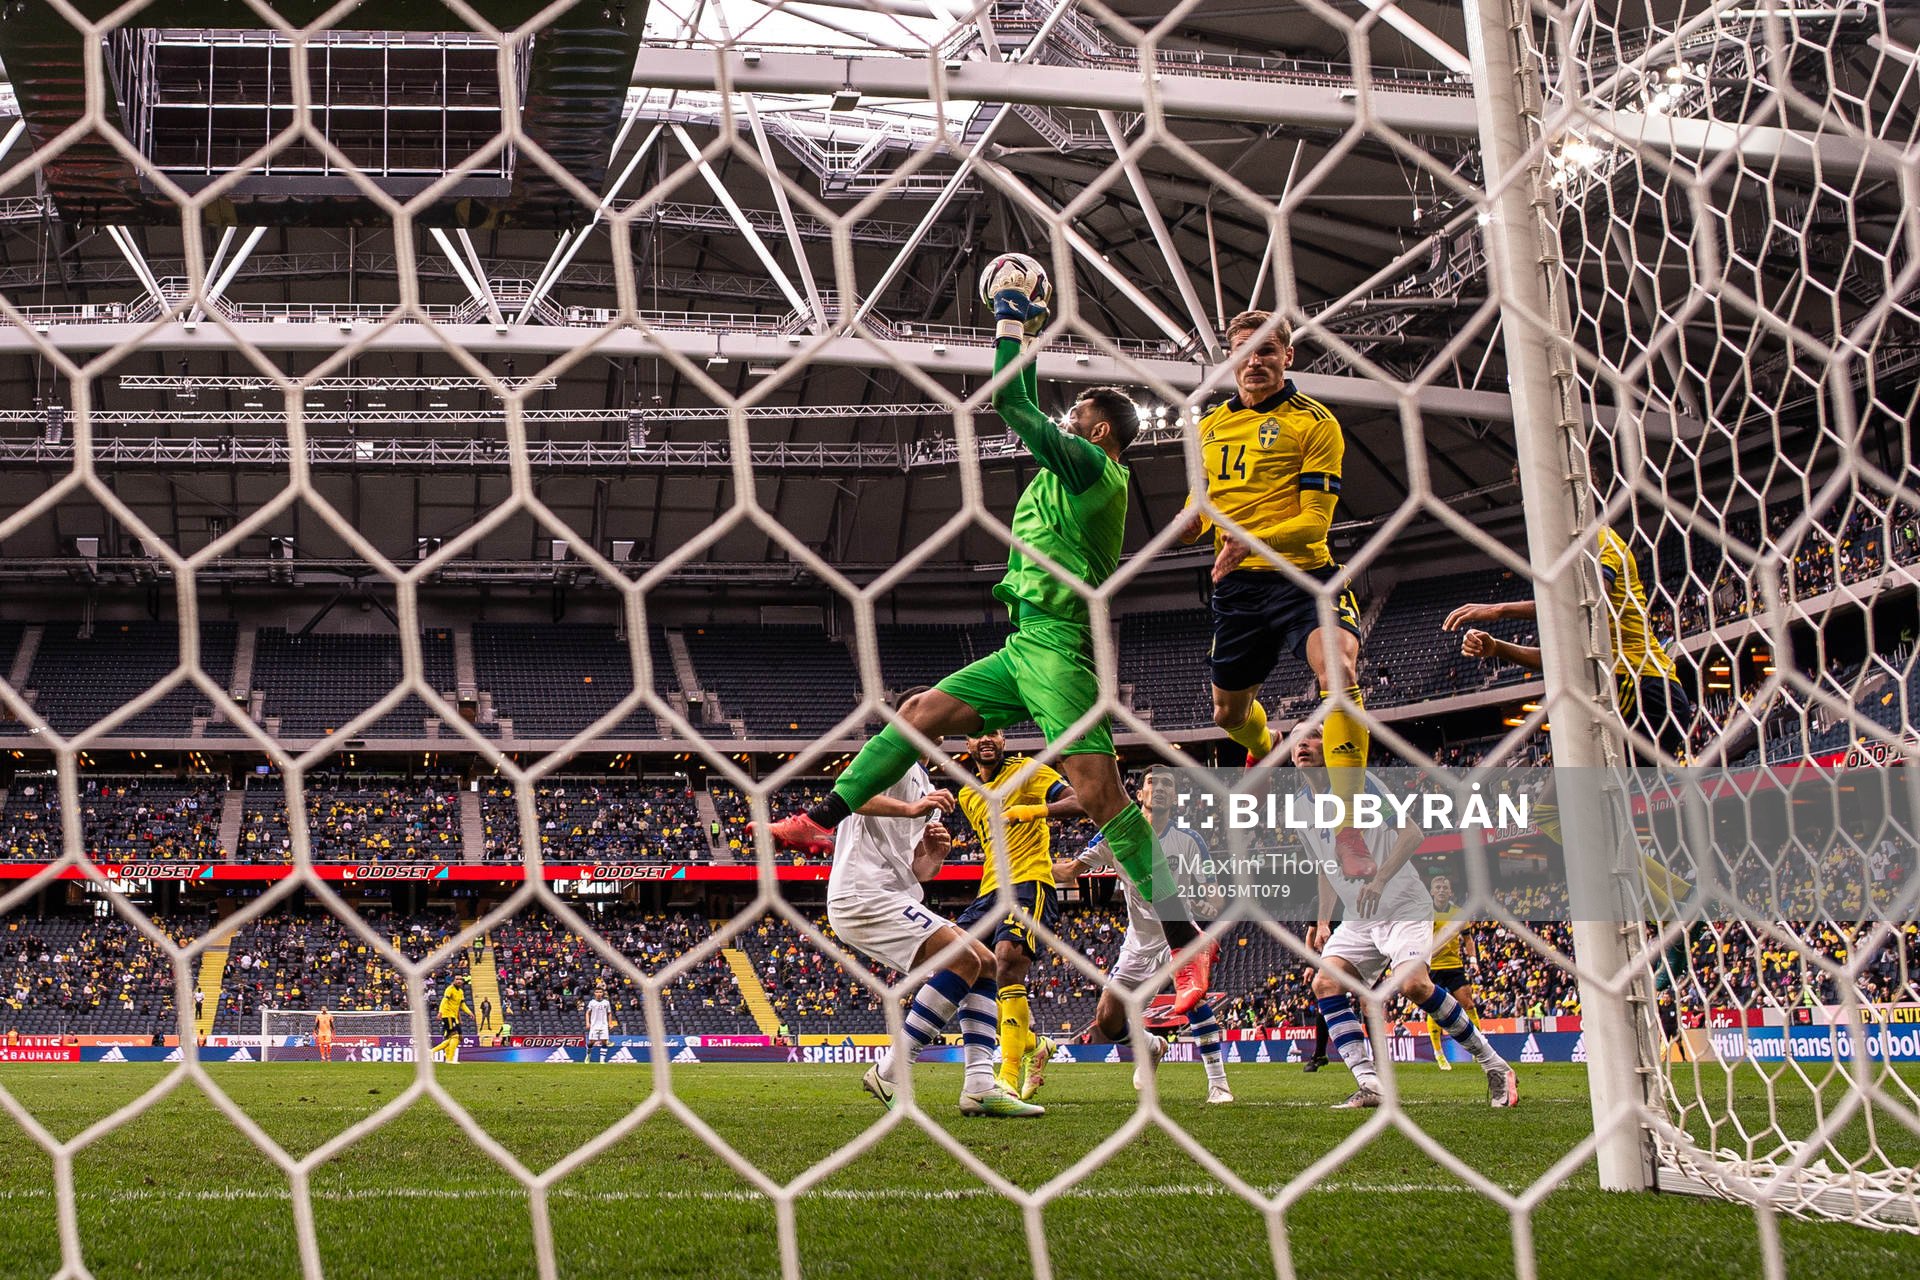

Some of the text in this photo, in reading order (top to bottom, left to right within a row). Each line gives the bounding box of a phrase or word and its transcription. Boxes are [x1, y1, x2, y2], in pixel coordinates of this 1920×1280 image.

[1217, 444, 1246, 480] 14
[120, 864, 200, 879] ODDSET
[356, 865, 435, 879] ODDSET
[593, 865, 672, 879] ODDSET
[903, 905, 933, 929] 5
[523, 1037, 584, 1047] ODDSET
[10, 1051, 70, 1060] BAUHAUS
[803, 1046, 893, 1063] SPEEDFLO
